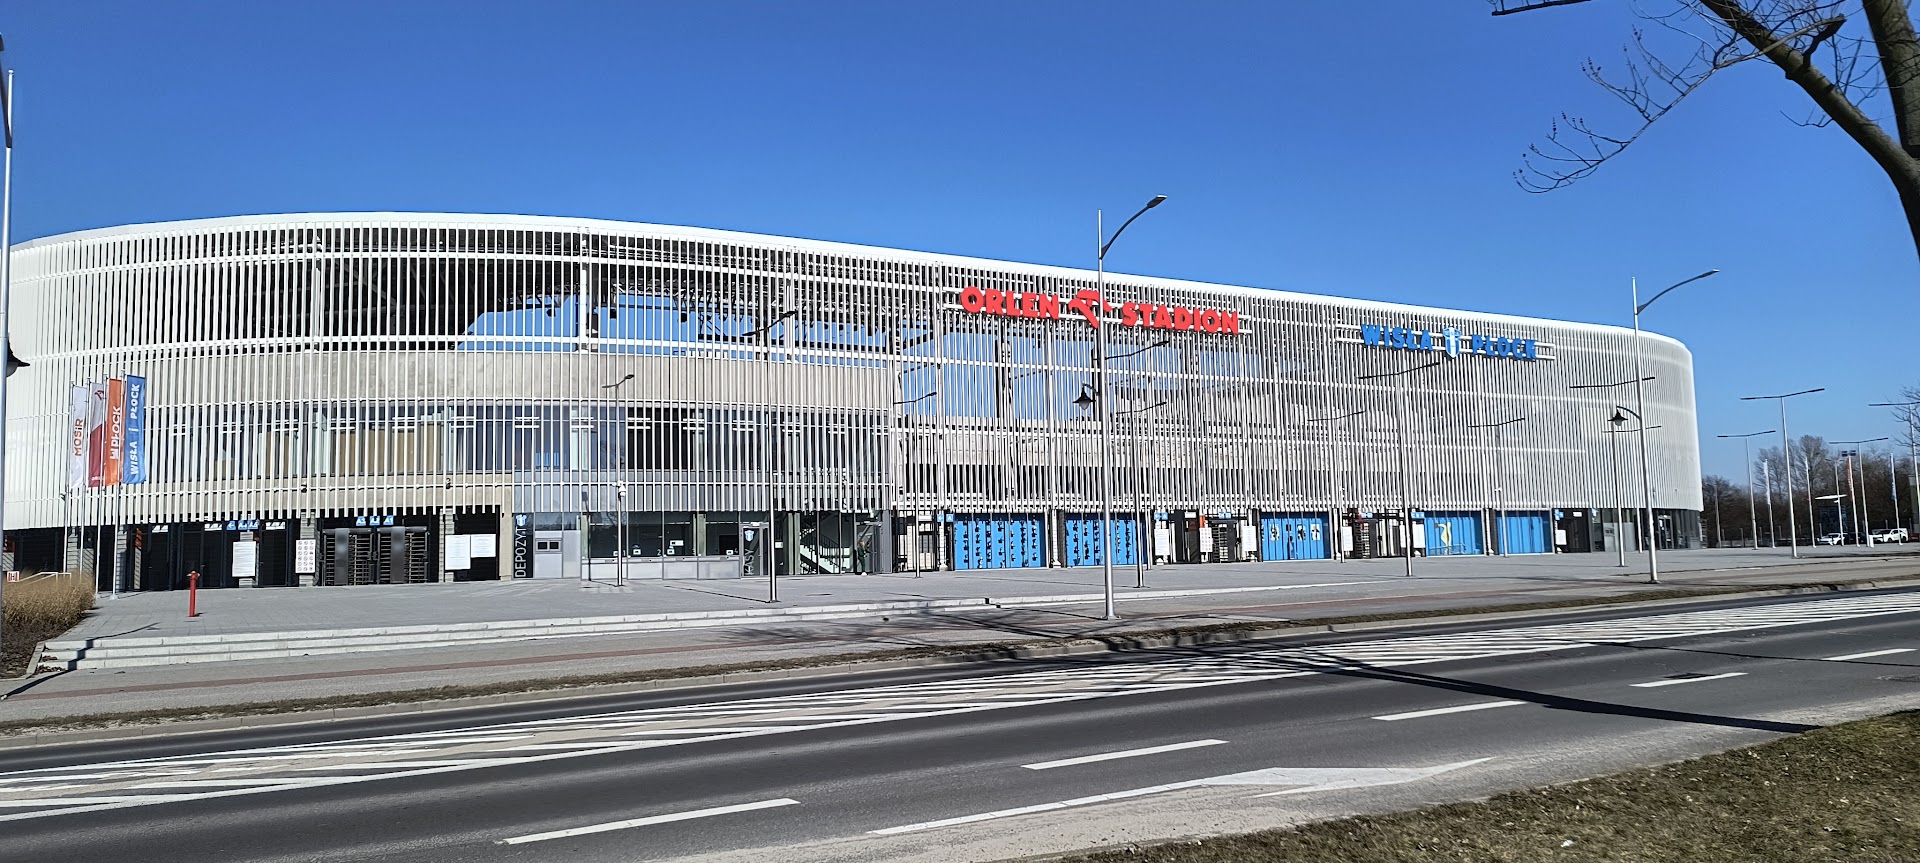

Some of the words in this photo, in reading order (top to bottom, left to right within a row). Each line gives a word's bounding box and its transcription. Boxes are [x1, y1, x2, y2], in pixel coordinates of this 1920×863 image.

[960, 286, 1059, 320] ORLEN
[1122, 302, 1239, 334] STADION
[1361, 324, 1433, 350] WISŁA
[1472, 334, 1537, 359] PŁOCK
[130, 384, 140, 420] PŁOCK
[129, 441, 139, 475] WISŁA
[514, 526, 527, 578] DEPOZYT
[744, 548, 754, 575] KASY
